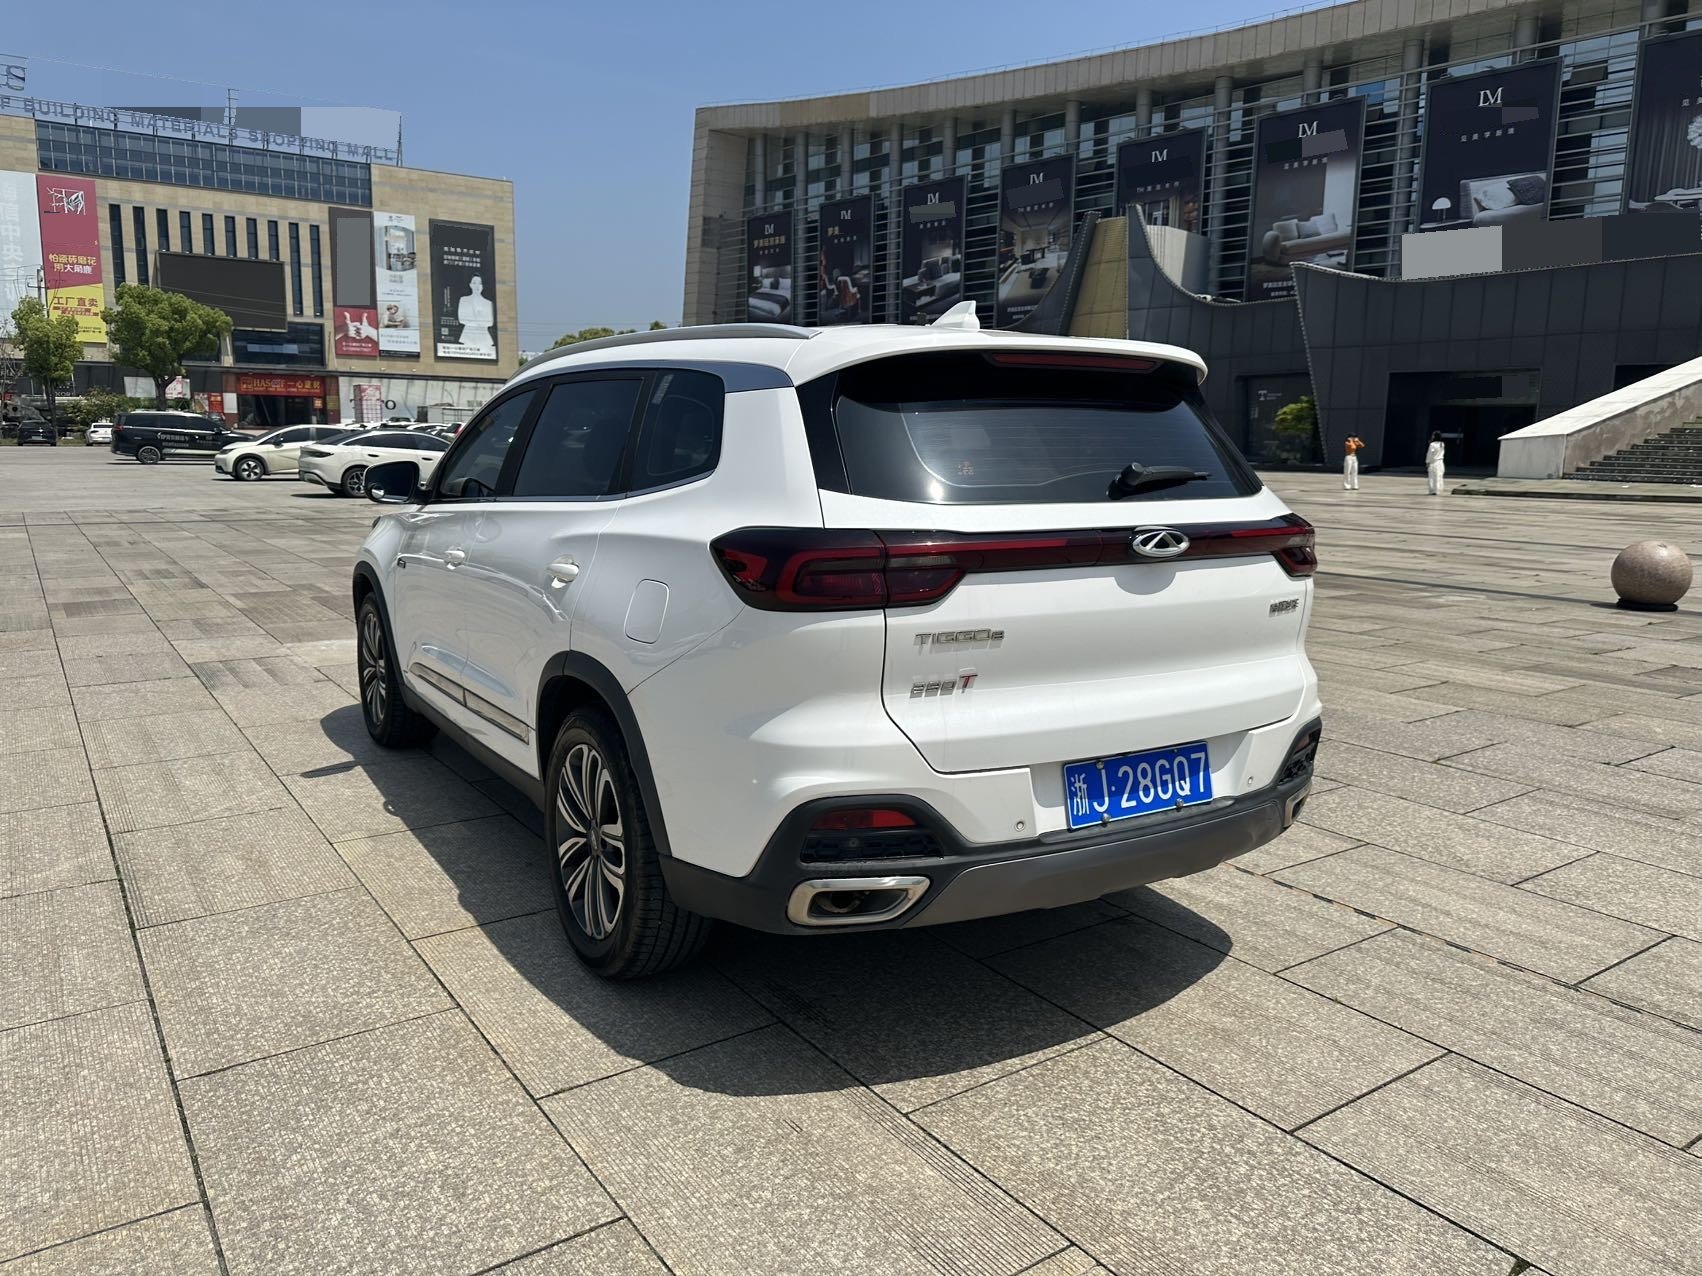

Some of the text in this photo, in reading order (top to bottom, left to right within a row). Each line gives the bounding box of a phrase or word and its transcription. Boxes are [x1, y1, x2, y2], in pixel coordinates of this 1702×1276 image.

[24, 98, 119, 123] BUILDING
[131, 113, 238, 140] MATERIALS
[347, 142, 394, 161] MALL
